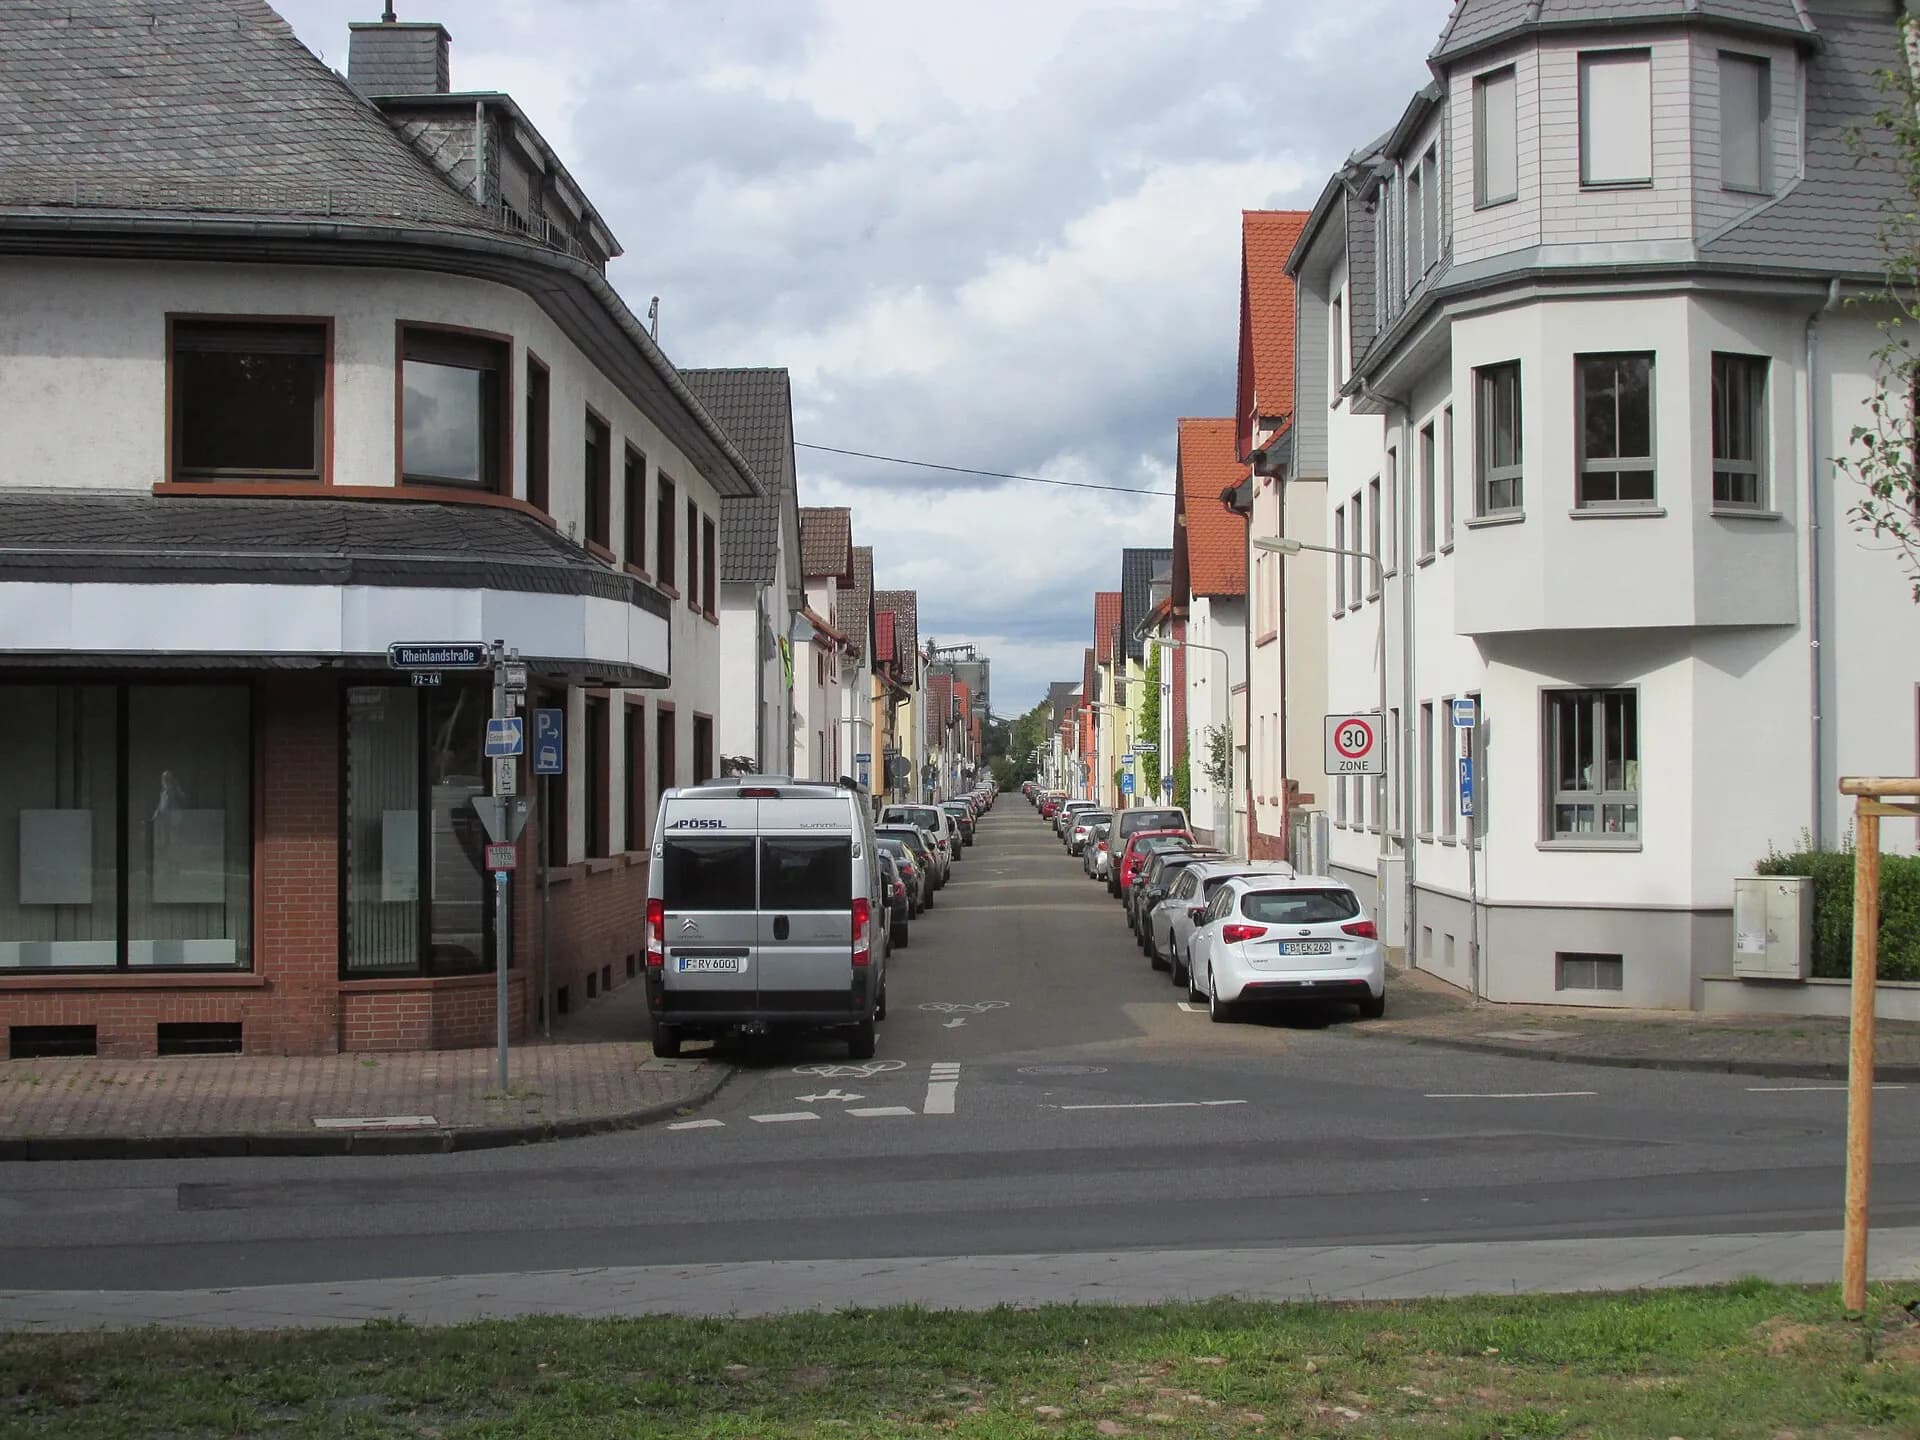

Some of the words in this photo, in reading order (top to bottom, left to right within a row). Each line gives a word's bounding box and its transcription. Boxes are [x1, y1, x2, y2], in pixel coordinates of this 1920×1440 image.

[402, 648, 475, 662] Rheinlandstraße
[413, 675, 440, 685] 72-64
[538, 713, 551, 739] P
[1343, 729, 1365, 748] 30
[1339, 760, 1369, 771] ZONE
[679, 817, 728, 829] PÖSSL
[1284, 943, 1297, 952] FB
[1301, 943, 1313, 952] EK
[1313, 943, 1329, 952] 262
[686, 960, 693, 969] F
[698, 960, 713, 969] RY
[713, 959, 737, 969] 6001
